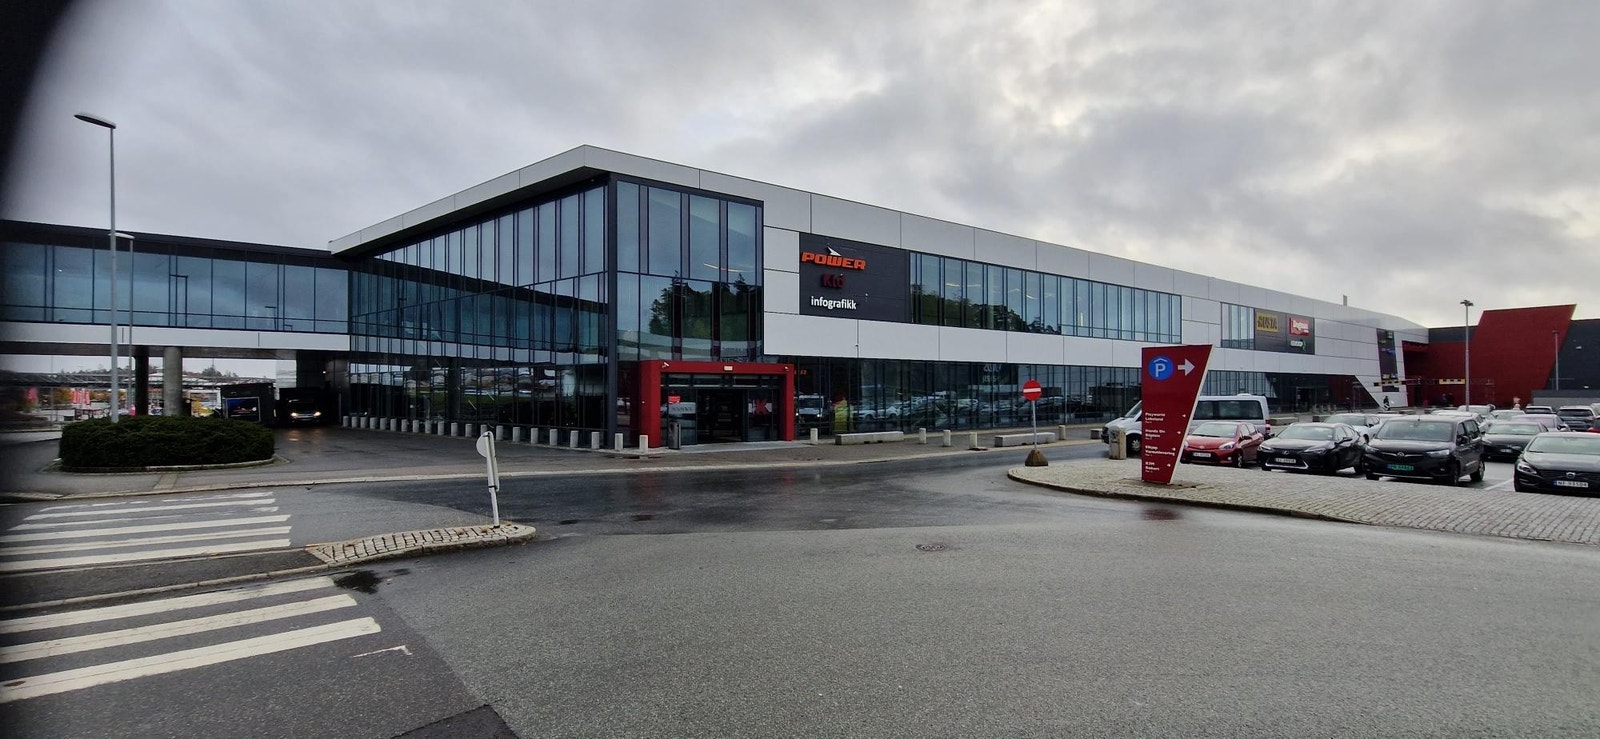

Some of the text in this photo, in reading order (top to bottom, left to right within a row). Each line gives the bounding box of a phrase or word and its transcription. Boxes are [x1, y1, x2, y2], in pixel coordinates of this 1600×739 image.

[801, 252, 866, 270] POWER
[811, 296, 857, 309] infografikk
[1155, 363, 1166, 377] P
